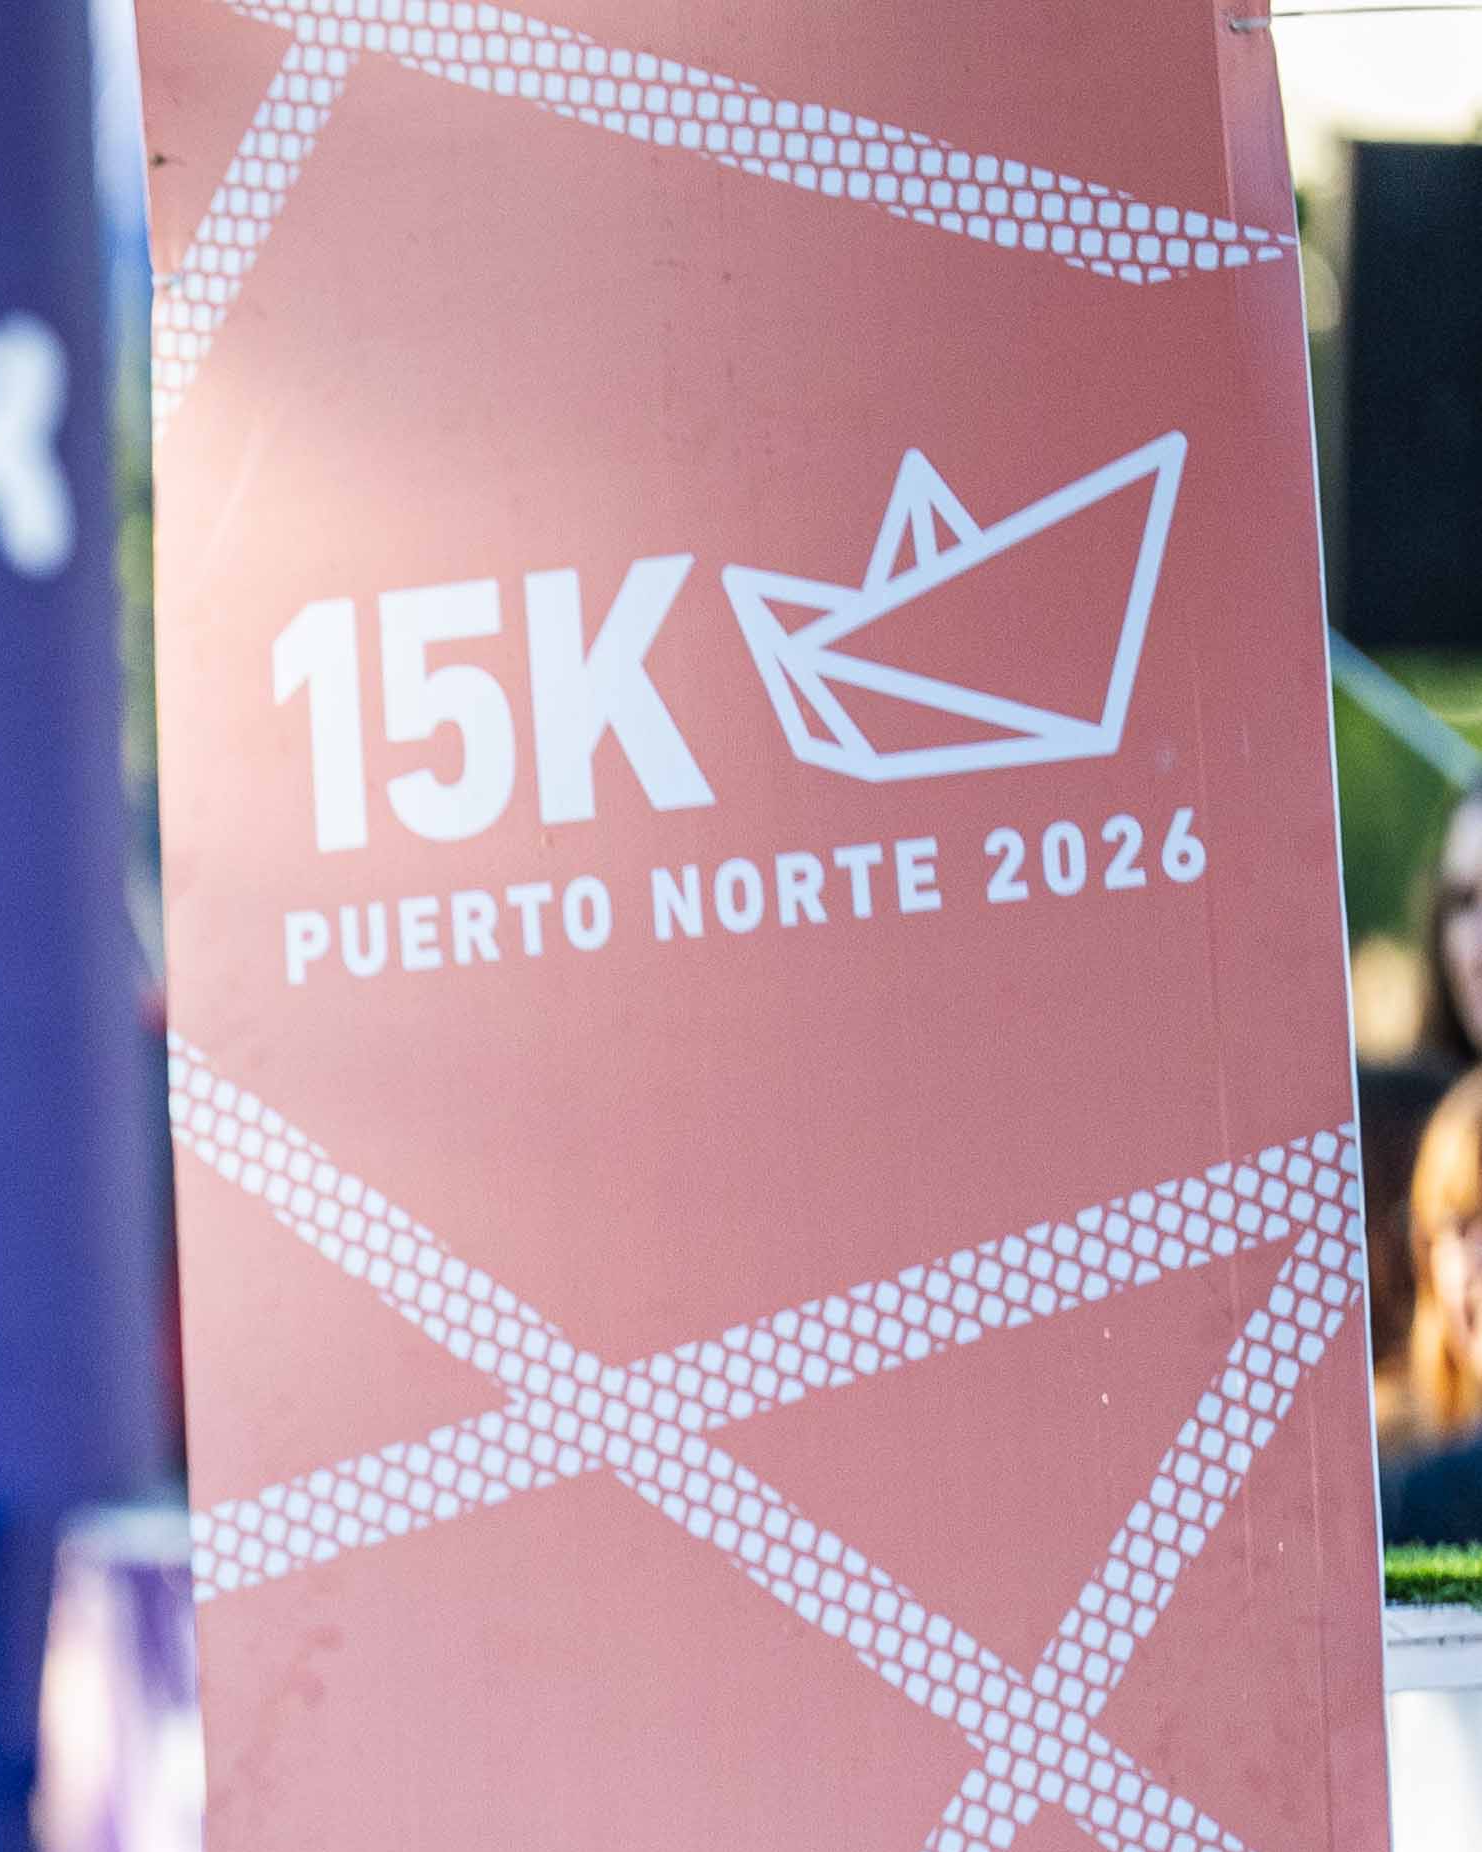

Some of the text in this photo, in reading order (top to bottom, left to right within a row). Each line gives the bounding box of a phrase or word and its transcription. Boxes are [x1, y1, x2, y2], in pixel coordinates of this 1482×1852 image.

[272, 553, 715, 852] 15K
[285, 807, 1207, 984] PUERTO NORTE 2026
